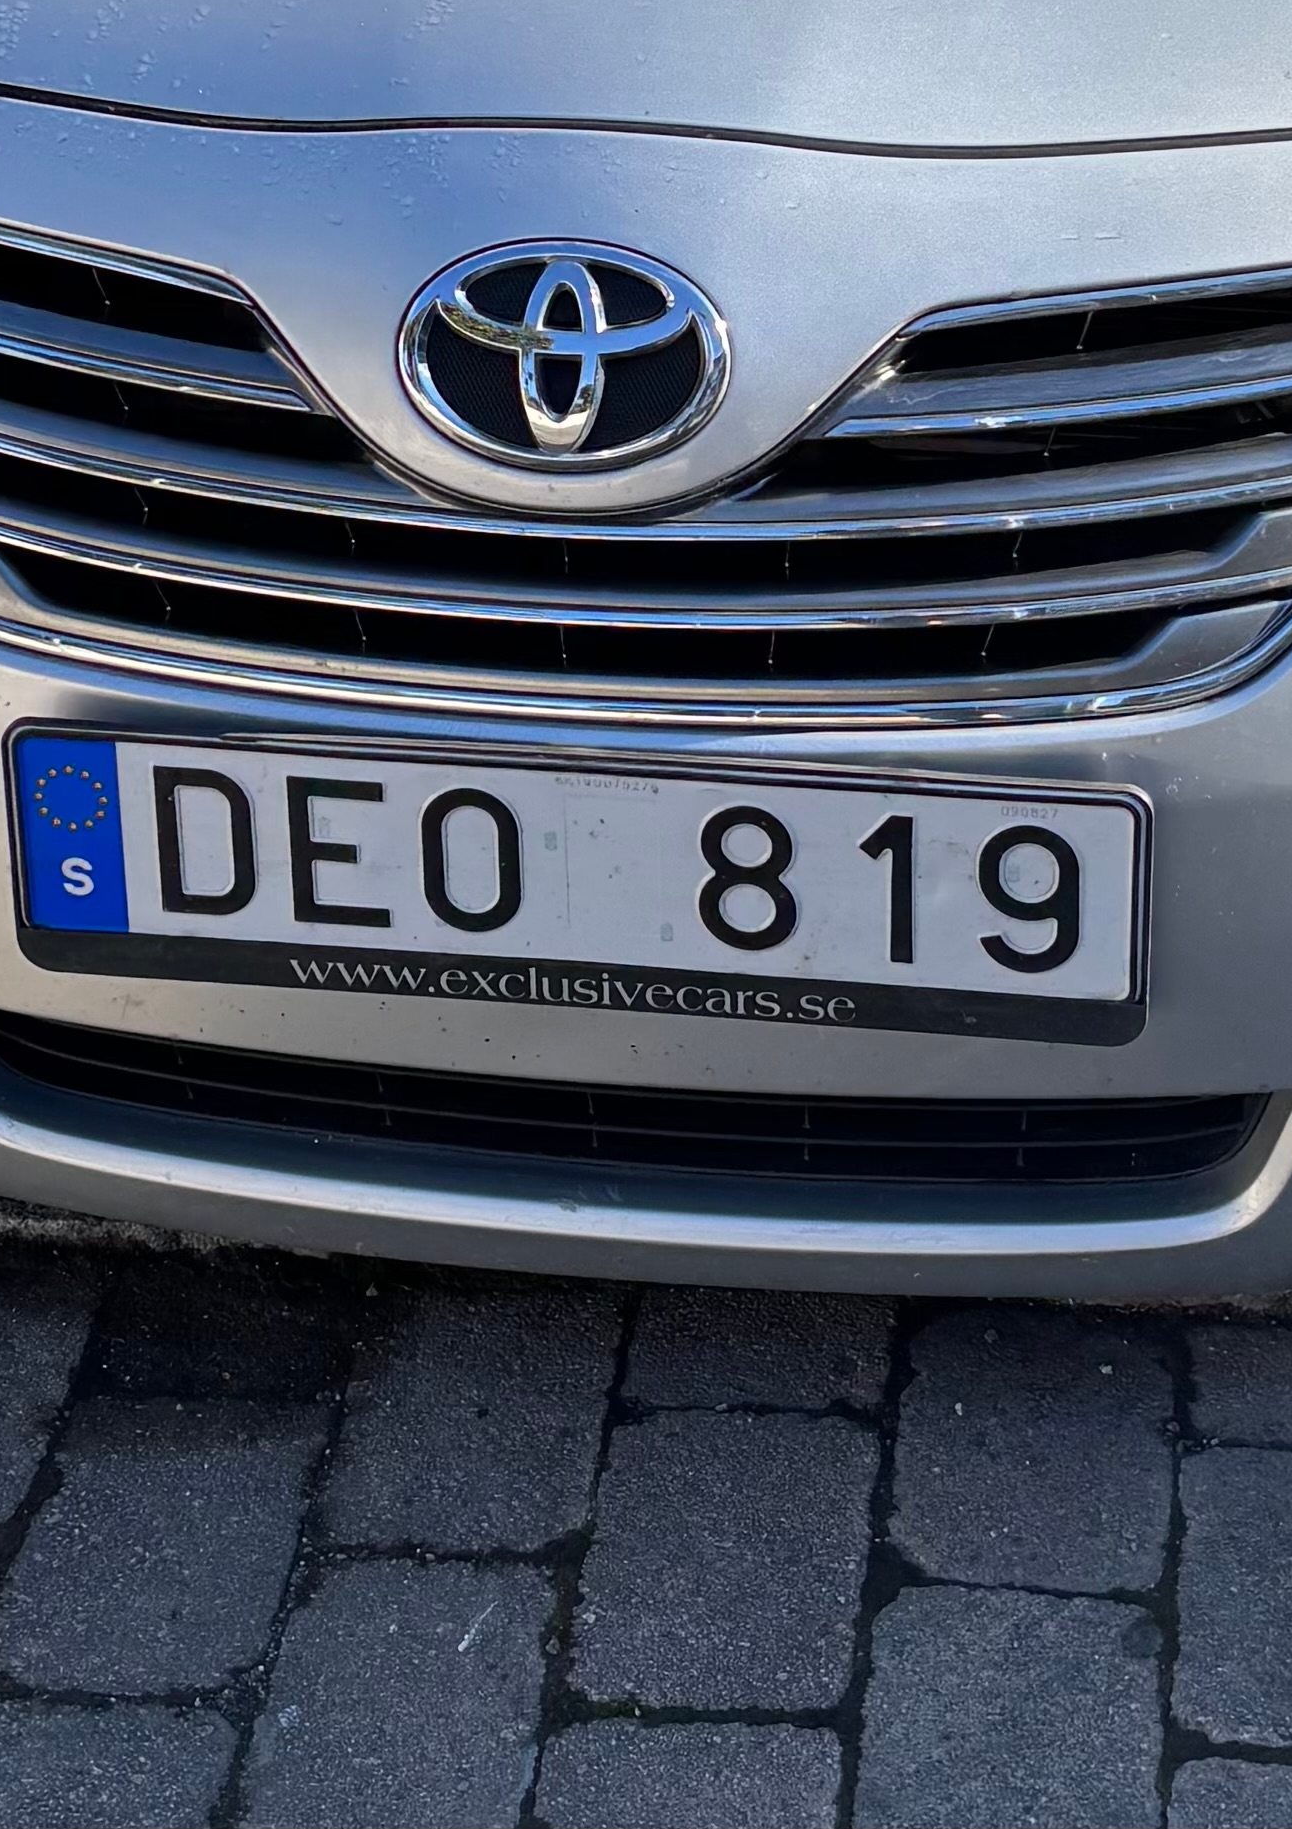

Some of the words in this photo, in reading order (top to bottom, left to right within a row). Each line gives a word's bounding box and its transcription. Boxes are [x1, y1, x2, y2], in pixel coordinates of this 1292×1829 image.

[61, 857, 95, 897] S
[152, 765, 523, 933] DEO
[698, 804, 1081, 974] 819
[289, 957, 857, 1024] www.exclusivecars.se
